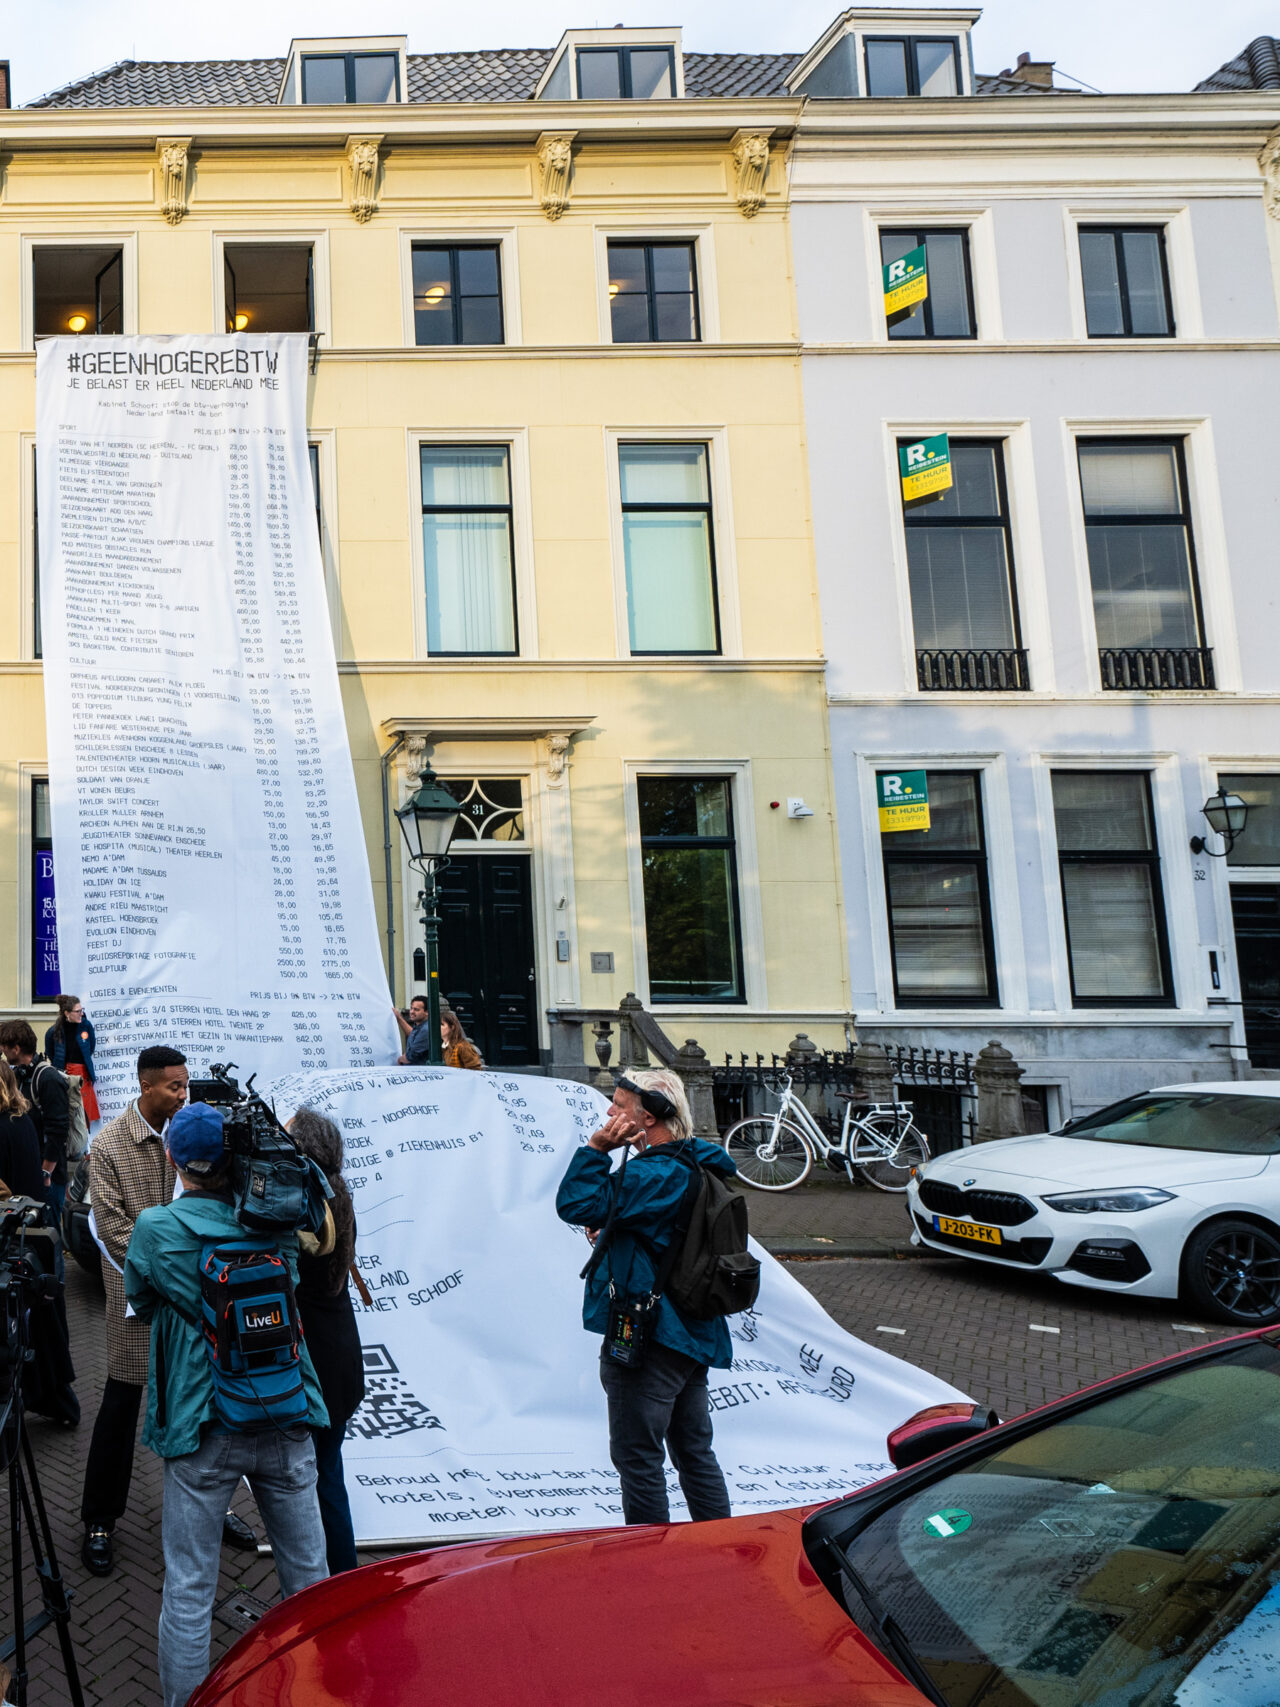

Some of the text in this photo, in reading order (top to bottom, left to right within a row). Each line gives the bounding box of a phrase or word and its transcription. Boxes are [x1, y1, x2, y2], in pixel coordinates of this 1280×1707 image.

[67, 349, 278, 375] #GEENHOGEREBTW
[67, 378, 279, 390] JE BELAST ER HEEL NEDERLAND MEE
[472, 804, 484, 815] 31
[900, 806, 925, 814] HUUR
[1194, 870, 1206, 881] 32
[87, 941, 108, 949] FEEST
[88, 965, 127, 974] SCULPTUUR
[90, 988, 116, 998] LOGIES
[129, 985, 177, 995] EVENEMENTEN
[91, 1009, 130, 1018] WEEKENDJE
[134, 1007, 148, 1015] WEG
[170, 1005, 200, 1013] STERREN
[203, 1007, 223, 1015] HOTEL
[154, 1019, 167, 1027] 3/4
[172, 1018, 201, 1026] STERREN
[205, 1020, 225, 1028] HOTEL
[230, 1021, 252, 1030] TWENTE
[97, 1036, 109, 1045] EEK
[114, 1031, 177, 1042] HERFSTVAKANTIE
[236, 1034, 283, 1043] VAKANTIEPARK
[296, 1035, 322, 1043] 842,00
[174, 1044, 213, 1053] AMSTERDAM
[95, 1061, 130, 1071] LOWLANDS
[301, 1060, 327, 1068] 650,00
[368, 1080, 382, 1088] V.
[96, 1086, 141, 1097] MYSTERYLAN
[382, 1105, 440, 1124] NOORDHOFF
[385, 1149, 394, 1158] @
[398, 1138, 466, 1153] ZIEKENHUIS
[346, 1172, 383, 1191] OEP 4
[943, 1220, 996, 1241] J-203-FK
[407, 1269, 464, 1306] SCHOOF
[245, 1310, 280, 1328] LiveU
[799, 1343, 824, 1378] NEE
[355, 1474, 441, 1487] Behoud
[496, 1468, 620, 1481] btw-tarie
[738, 1464, 831, 1475] Cultuur
[376, 1489, 475, 1504] hotels,
[488, 1485, 623, 1499] evenemente
[736, 1480, 768, 1491] en
[428, 1504, 516, 1523] moeten
[524, 1505, 580, 1518] voor
